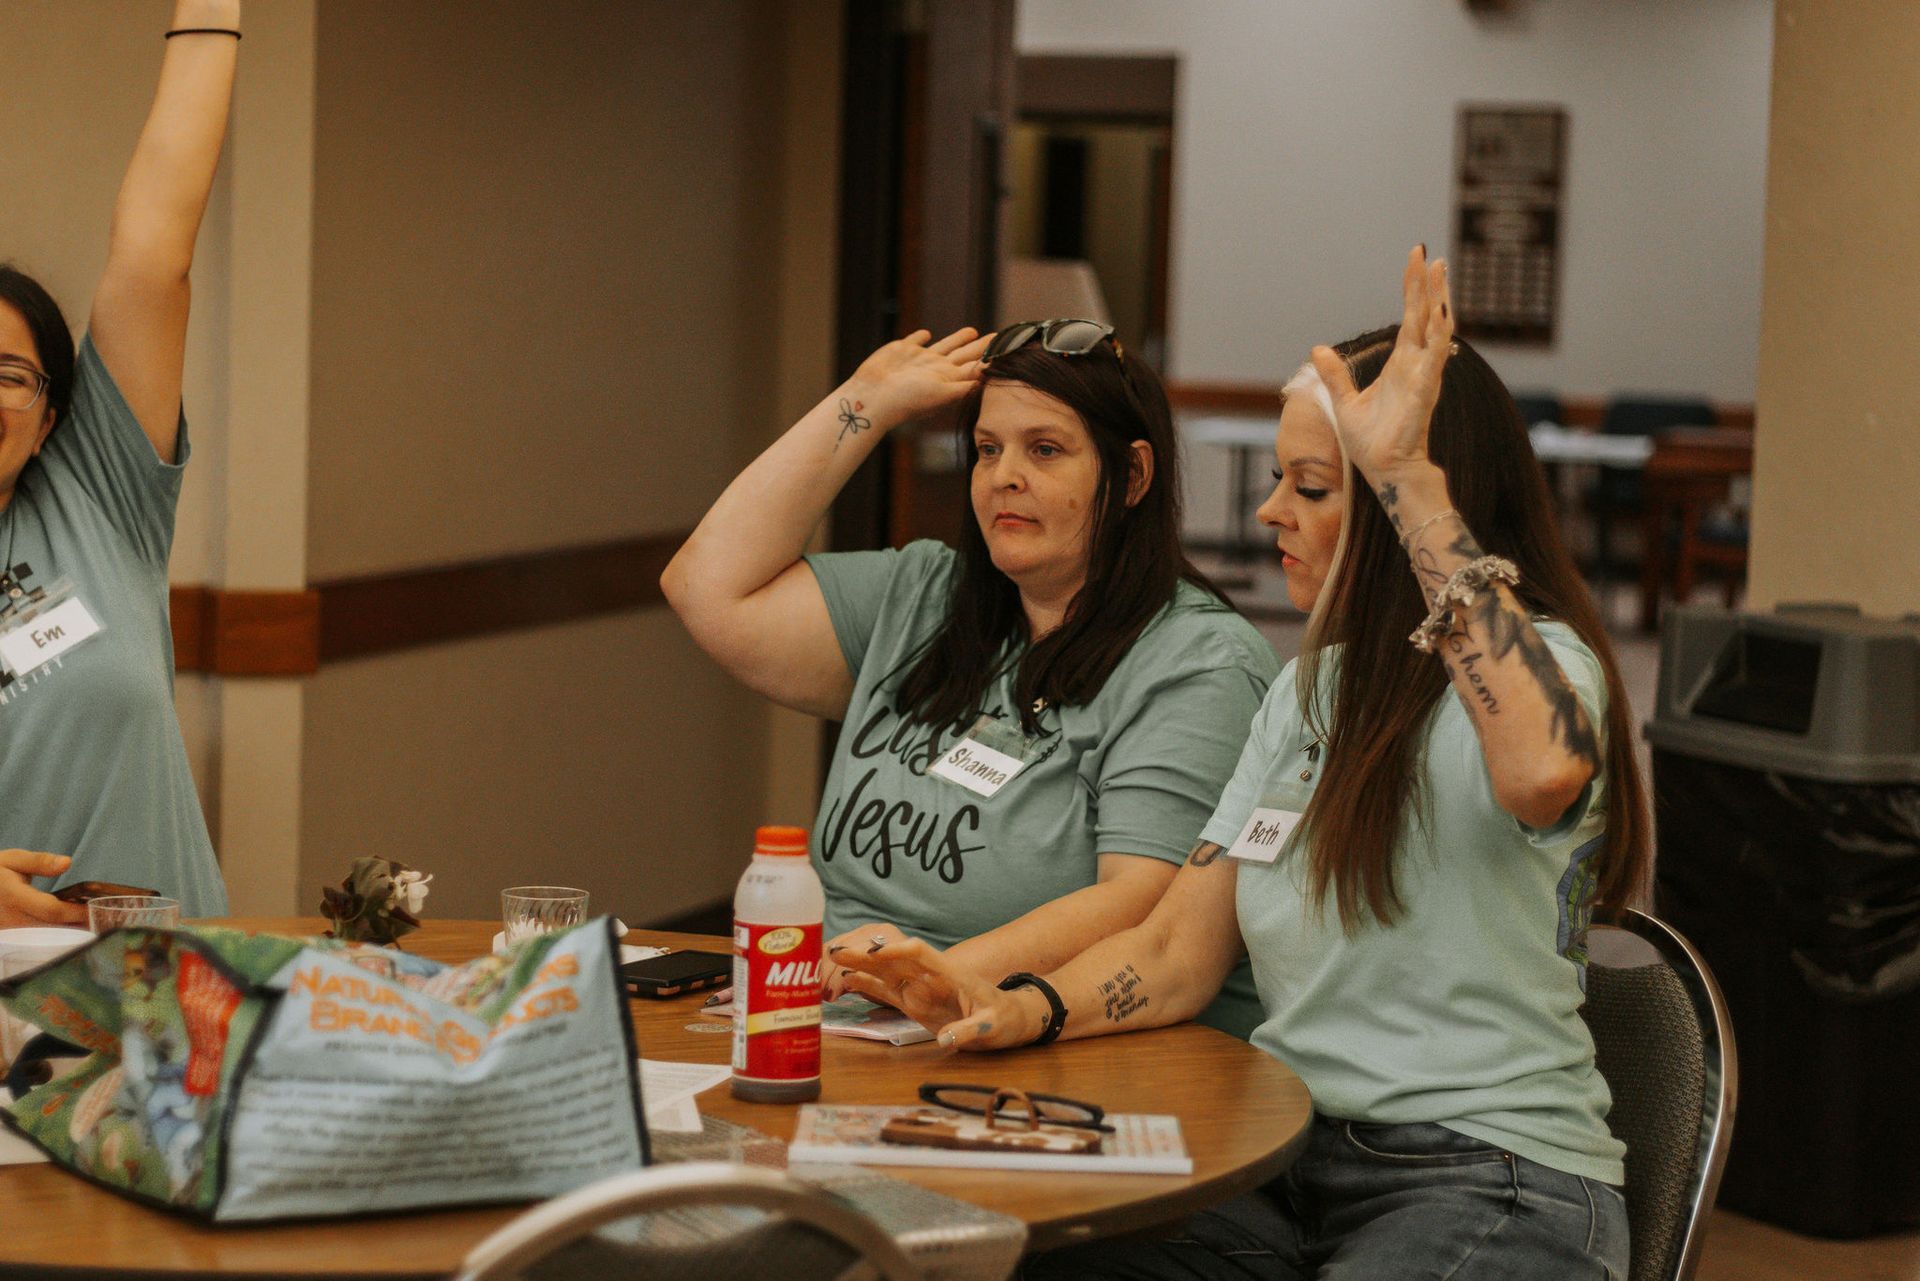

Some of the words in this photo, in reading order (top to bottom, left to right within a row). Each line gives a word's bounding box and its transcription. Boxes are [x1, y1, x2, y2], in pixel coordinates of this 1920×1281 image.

[30, 624, 66, 649] Em
[948, 747, 1008, 786] Shanna
[822, 768, 986, 884] Jesus
[1247, 820, 1281, 846] Beth
